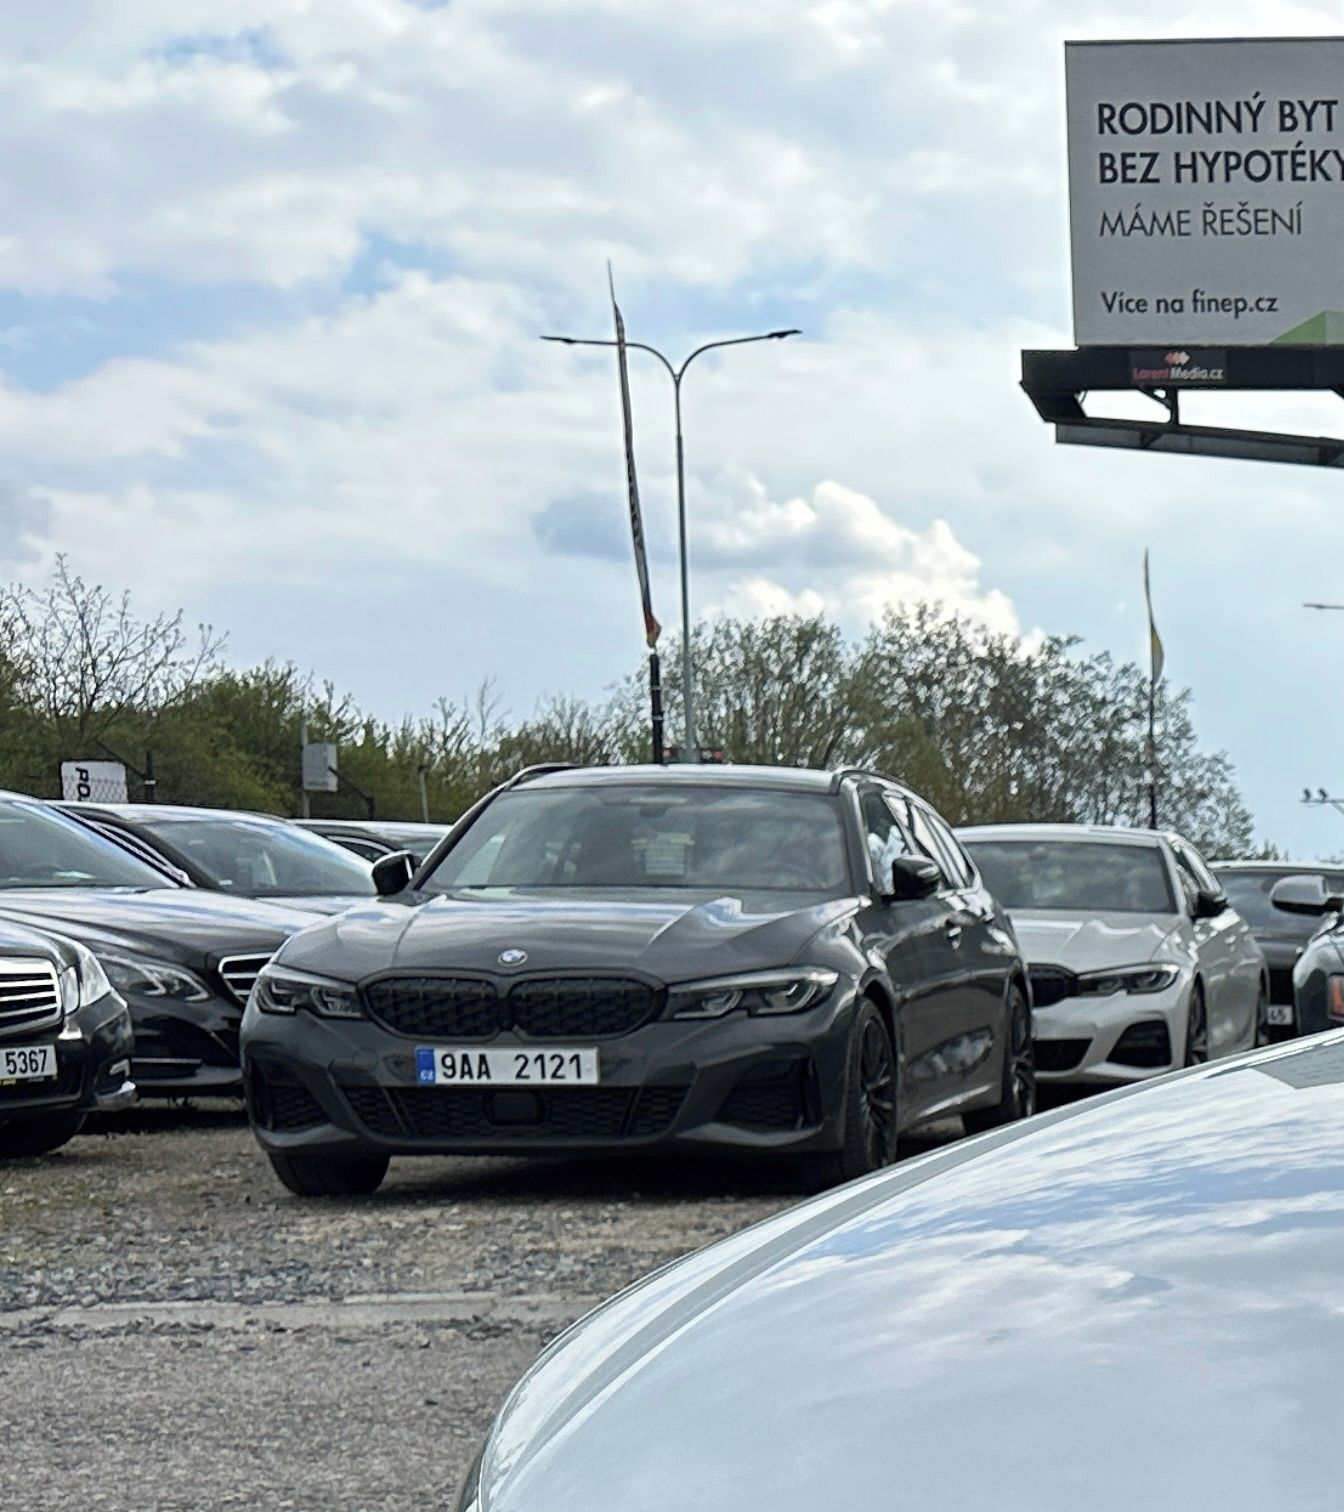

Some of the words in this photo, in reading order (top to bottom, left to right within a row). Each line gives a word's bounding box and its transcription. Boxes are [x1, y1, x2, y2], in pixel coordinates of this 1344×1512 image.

[1098, 91, 1266, 134] RODINNÝ
[1279, 100, 1338, 132] BYT
[1099, 152, 1160, 184] BEZ
[1099, 203, 1191, 237] MÁME
[1202, 201, 1303, 236] ŘEŠENÍ
[1100, 291, 1148, 313] Více
[1156, 298, 1184, 313] na
[1191, 288, 1279, 319] finep.cz
[5, 1048, 47, 1075] 5367
[441, 1053, 491, 1080] 9AA
[514, 1053, 582, 1080] 2121
